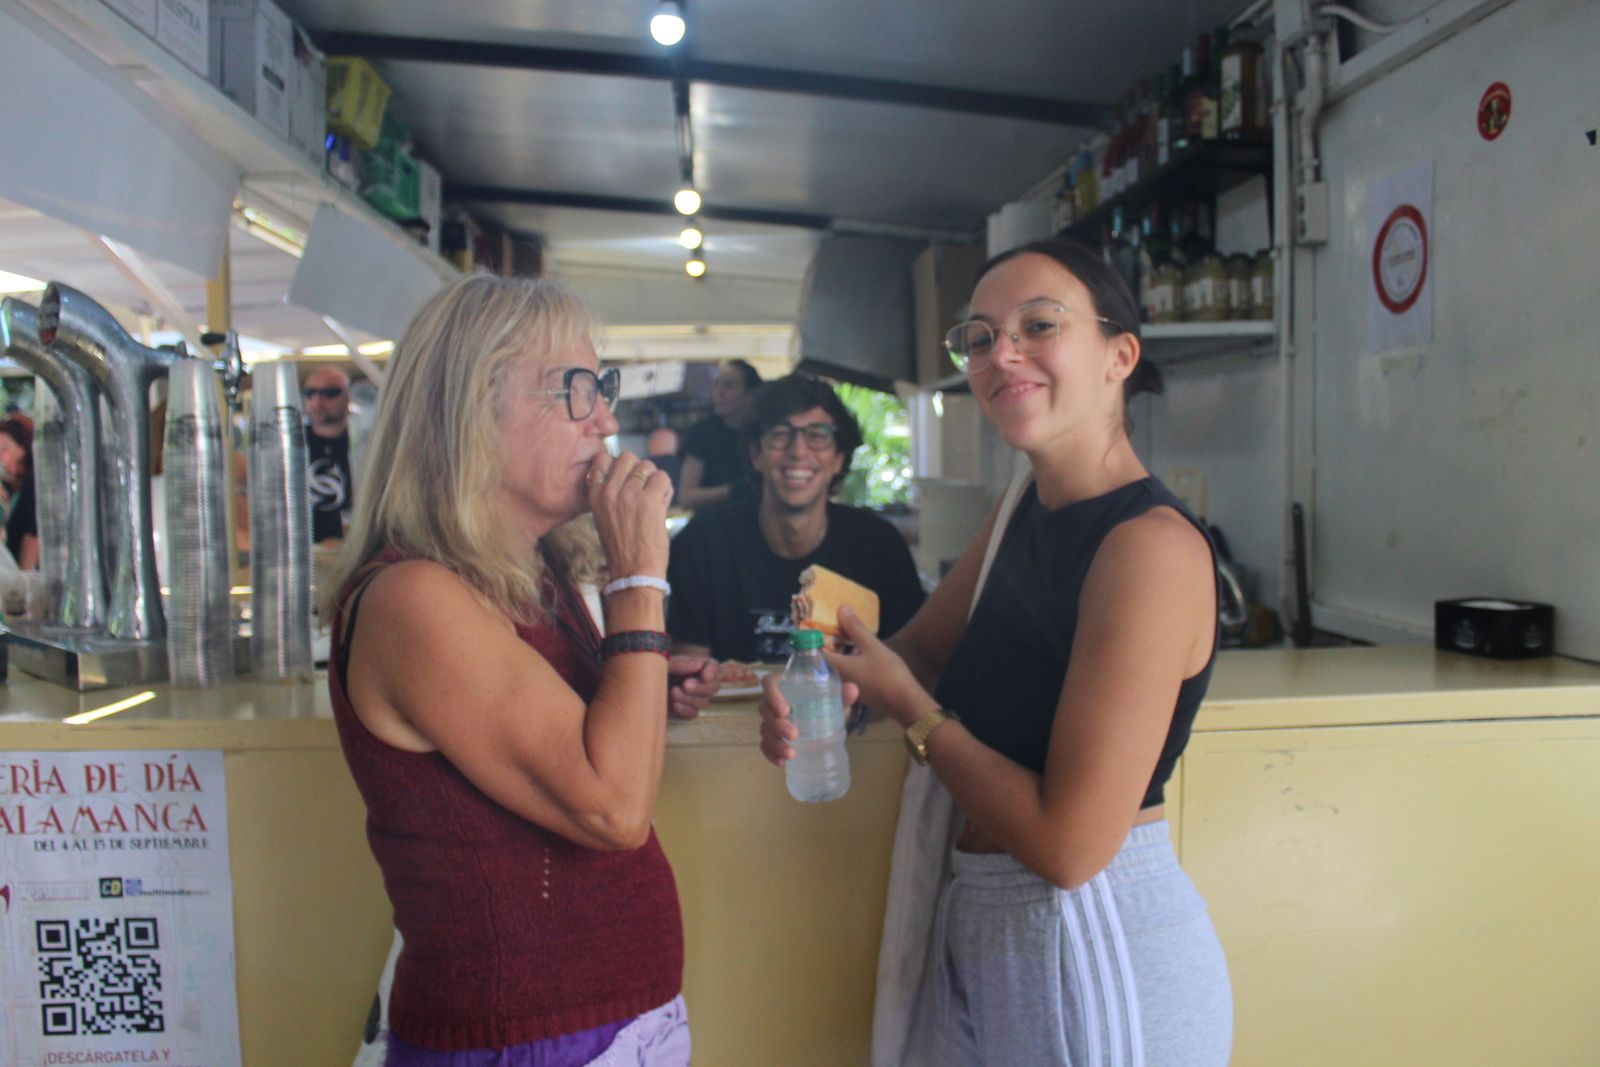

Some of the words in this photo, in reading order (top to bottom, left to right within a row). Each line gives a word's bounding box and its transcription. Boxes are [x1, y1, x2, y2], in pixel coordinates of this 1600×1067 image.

[84, 763, 128, 793] DE
[144, 754, 202, 793] DÍA
[34, 840, 55, 852] DEL
[61, 840, 68, 851] 4
[72, 839, 88, 851] AL
[110, 839, 125, 850] DE
[129, 838, 208, 850] SEPTIEMBRE
[162, 1049, 170, 1061] Y
